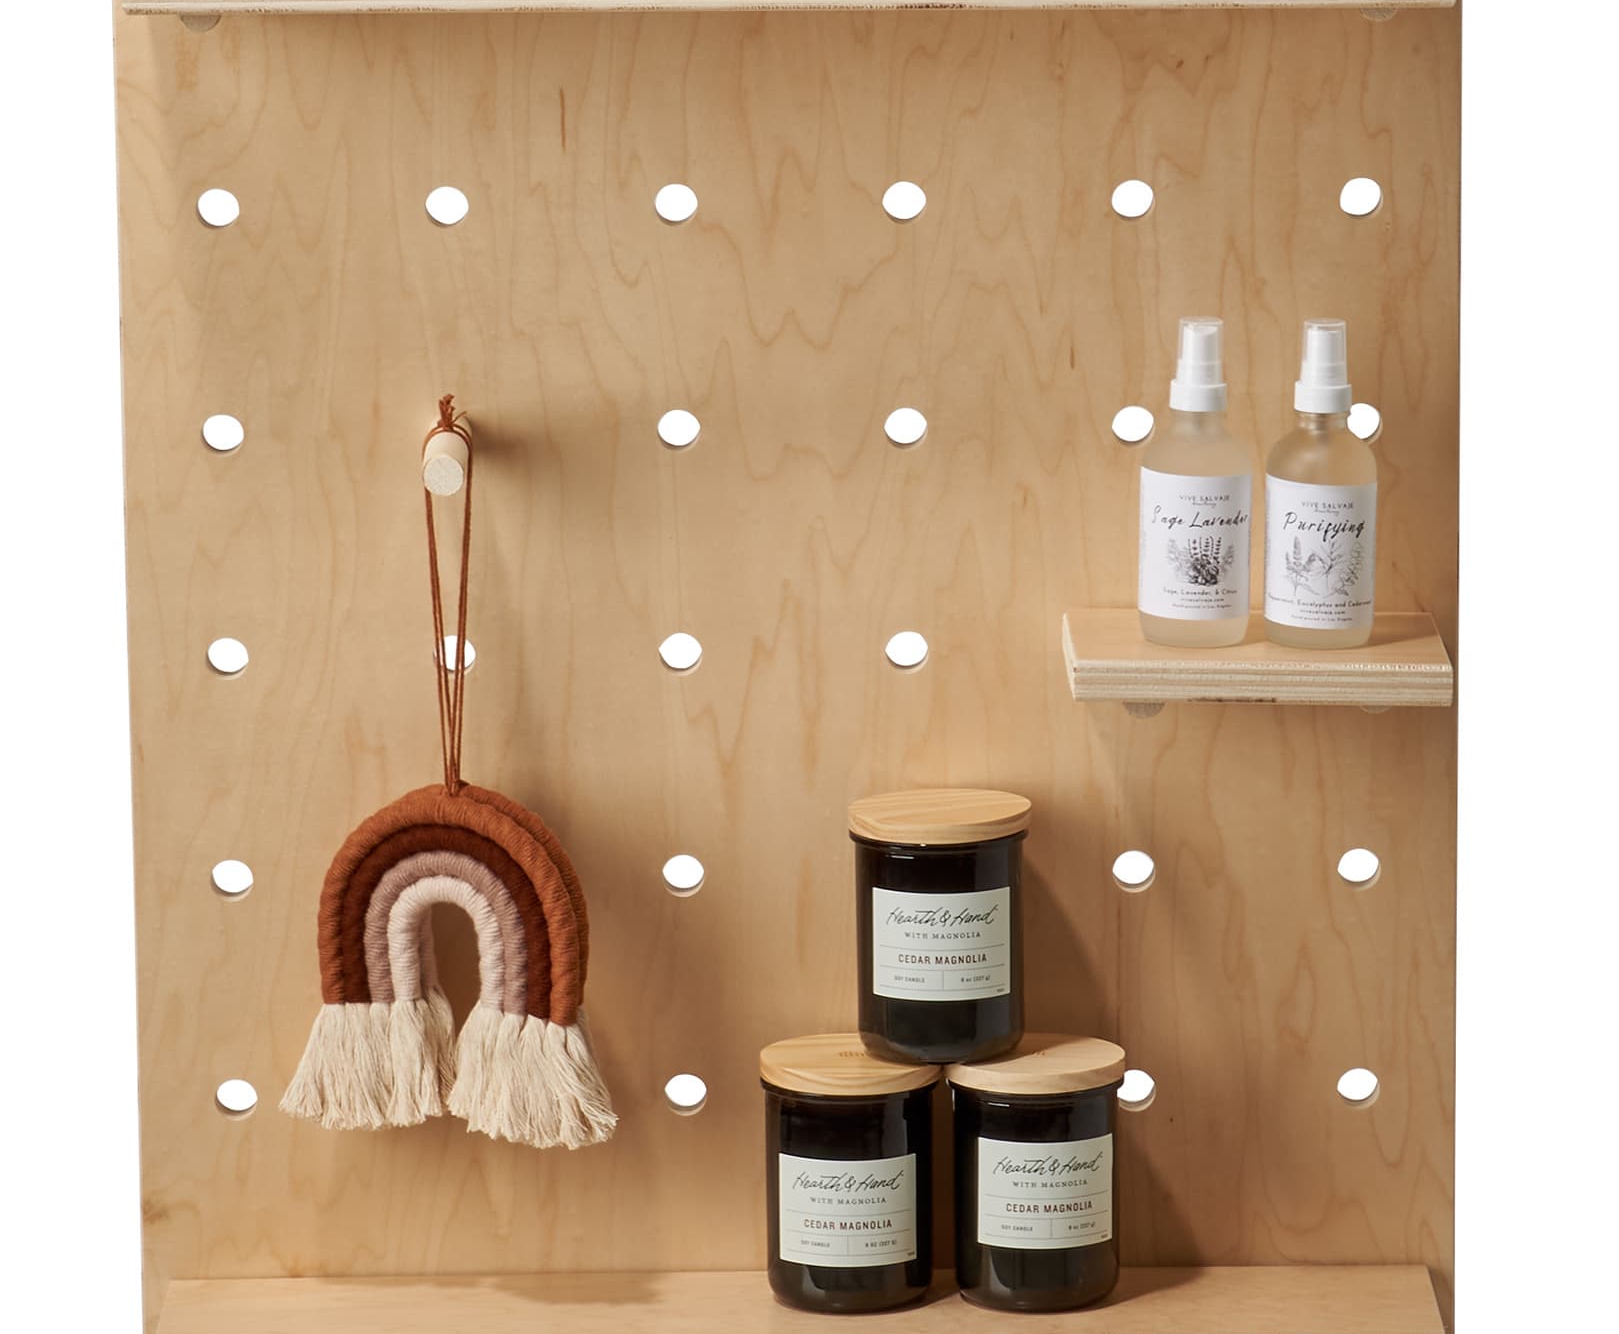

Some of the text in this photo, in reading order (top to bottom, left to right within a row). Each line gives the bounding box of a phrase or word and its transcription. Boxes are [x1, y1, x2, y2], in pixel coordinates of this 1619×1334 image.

[1283, 511, 1366, 542] Purifying
[886, 907, 944, 927] Hearth
[905, 931, 981, 940] WITH MAGNOLIA
[898, 953, 987, 966] CEDAR MAGNOLIA
[993, 1156, 1051, 1176] Hearth
[792, 1171, 848, 1192] Hearth
[1041, 1179, 1088, 1188] MAGNOLIA
[810, 1196, 887, 1205] WITH MAGNOLIA
[1006, 1200, 1093, 1214] CEDAR MAGNOLIA
[804, 1219, 893, 1231] CEDAR MAGNOLIA
